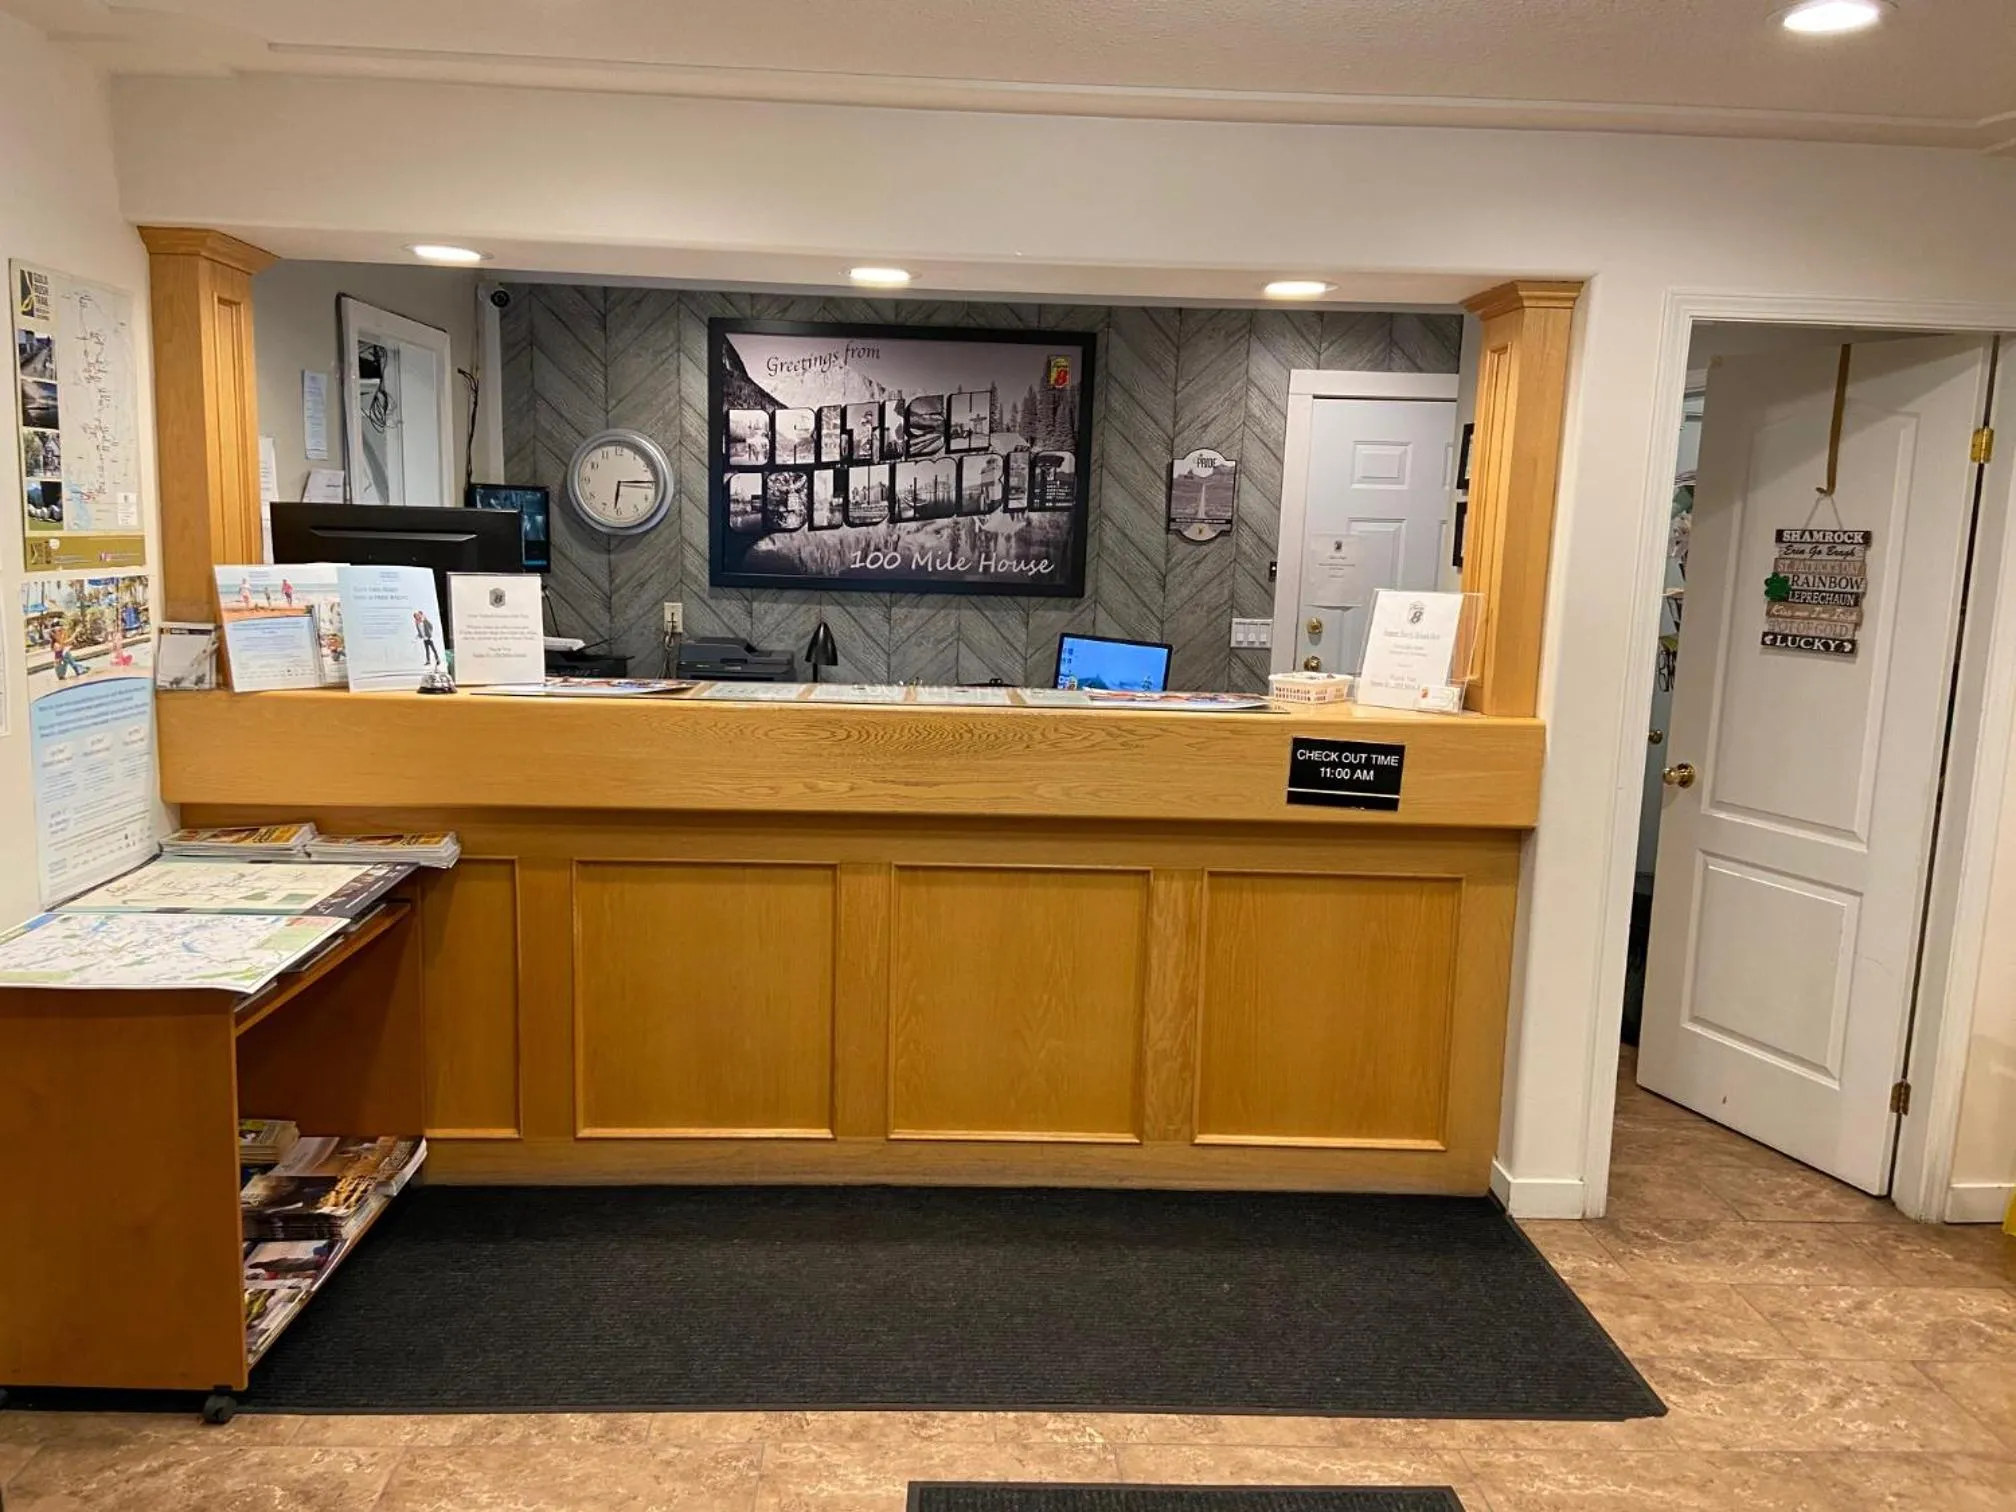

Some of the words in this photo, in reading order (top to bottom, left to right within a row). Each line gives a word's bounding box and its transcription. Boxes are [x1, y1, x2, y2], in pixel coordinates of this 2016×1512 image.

[766, 349, 840, 377] Greetings
[839, 340, 881, 369] from
[1782, 529, 1865, 544] SHAMROCK
[1784, 544, 1806, 556] Erin
[1809, 545, 1823, 559] Go
[850, 551, 901, 570] 100
[911, 550, 972, 572] Mile
[978, 551, 1055, 576] House
[1792, 575, 1865, 590] RAINBOW
[1789, 592, 1855, 605] LEPRECHAUN
[1776, 635, 1842, 652] LUCKY
[1296, 749, 1339, 763] CHECK
[1341, 751, 1368, 765] OUT
[1370, 754, 1400, 767] TIME
[1319, 766, 1351, 780] 11:00
[1352, 769, 1375, 781] AM
